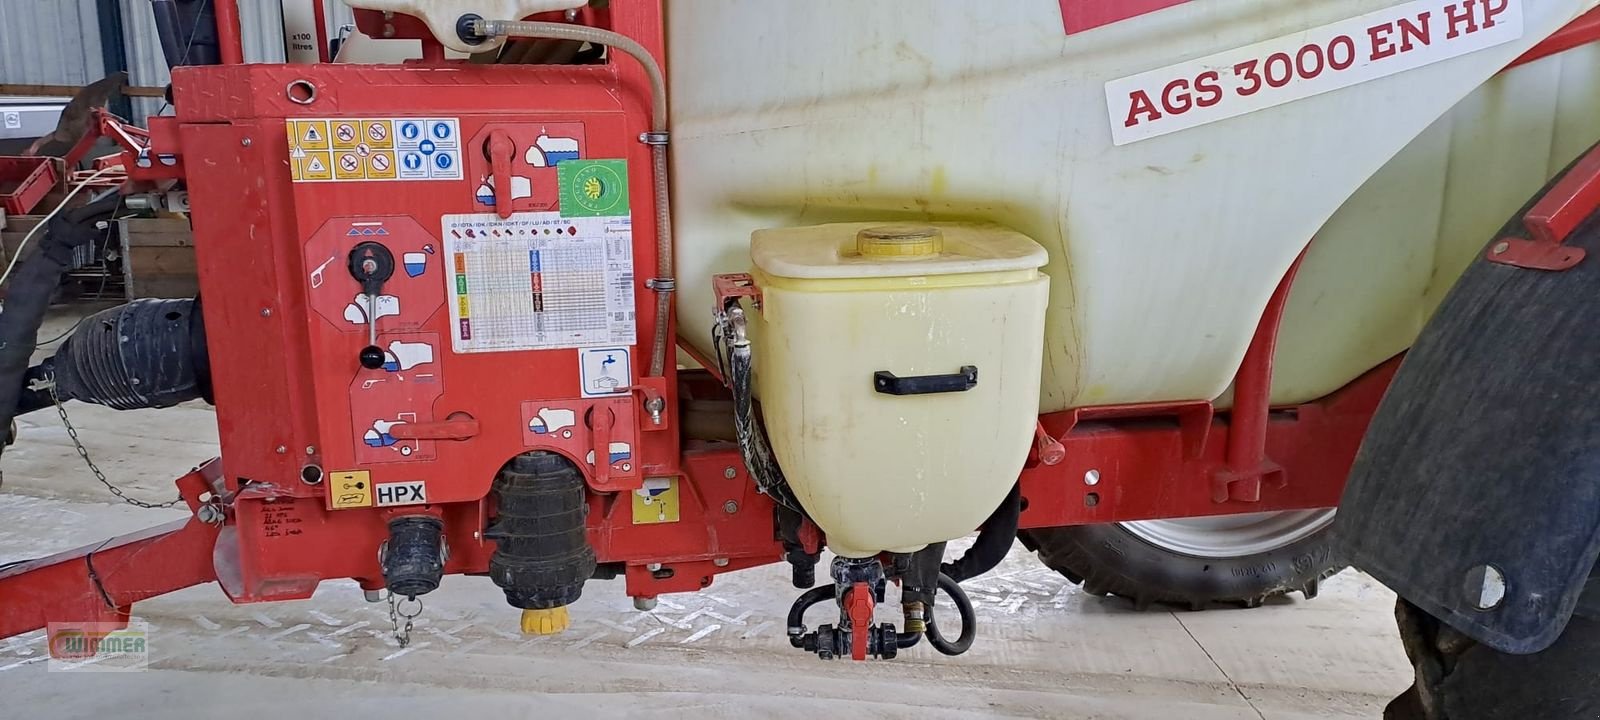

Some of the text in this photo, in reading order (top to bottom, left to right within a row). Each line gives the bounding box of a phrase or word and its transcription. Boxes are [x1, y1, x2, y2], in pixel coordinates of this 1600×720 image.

[1124, 0, 1509, 127] AGS 3000 EN HP
[377, 484, 425, 504] HPX
